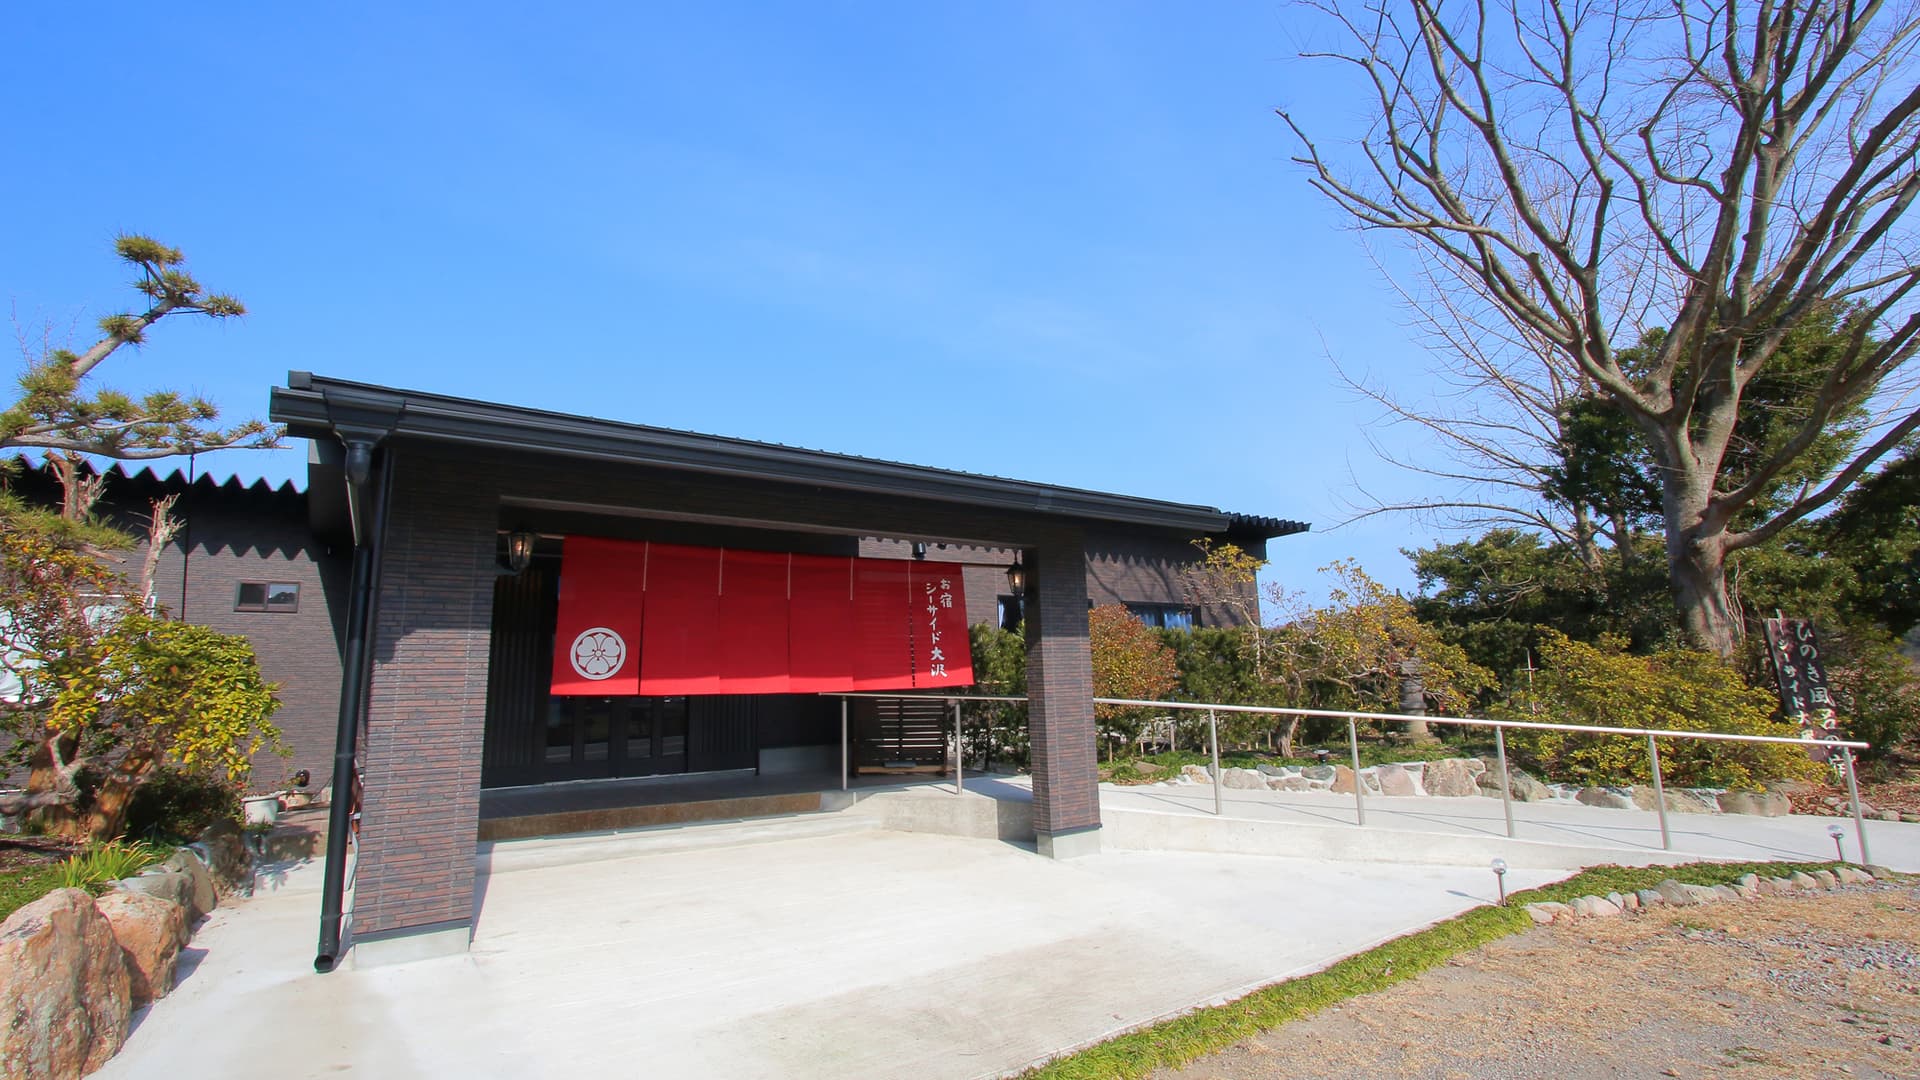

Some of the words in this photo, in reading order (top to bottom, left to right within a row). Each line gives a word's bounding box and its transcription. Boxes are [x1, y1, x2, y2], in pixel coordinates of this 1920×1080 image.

[940, 579, 953, 608] お宿
[926, 583, 948, 677] シーサイド大沢
